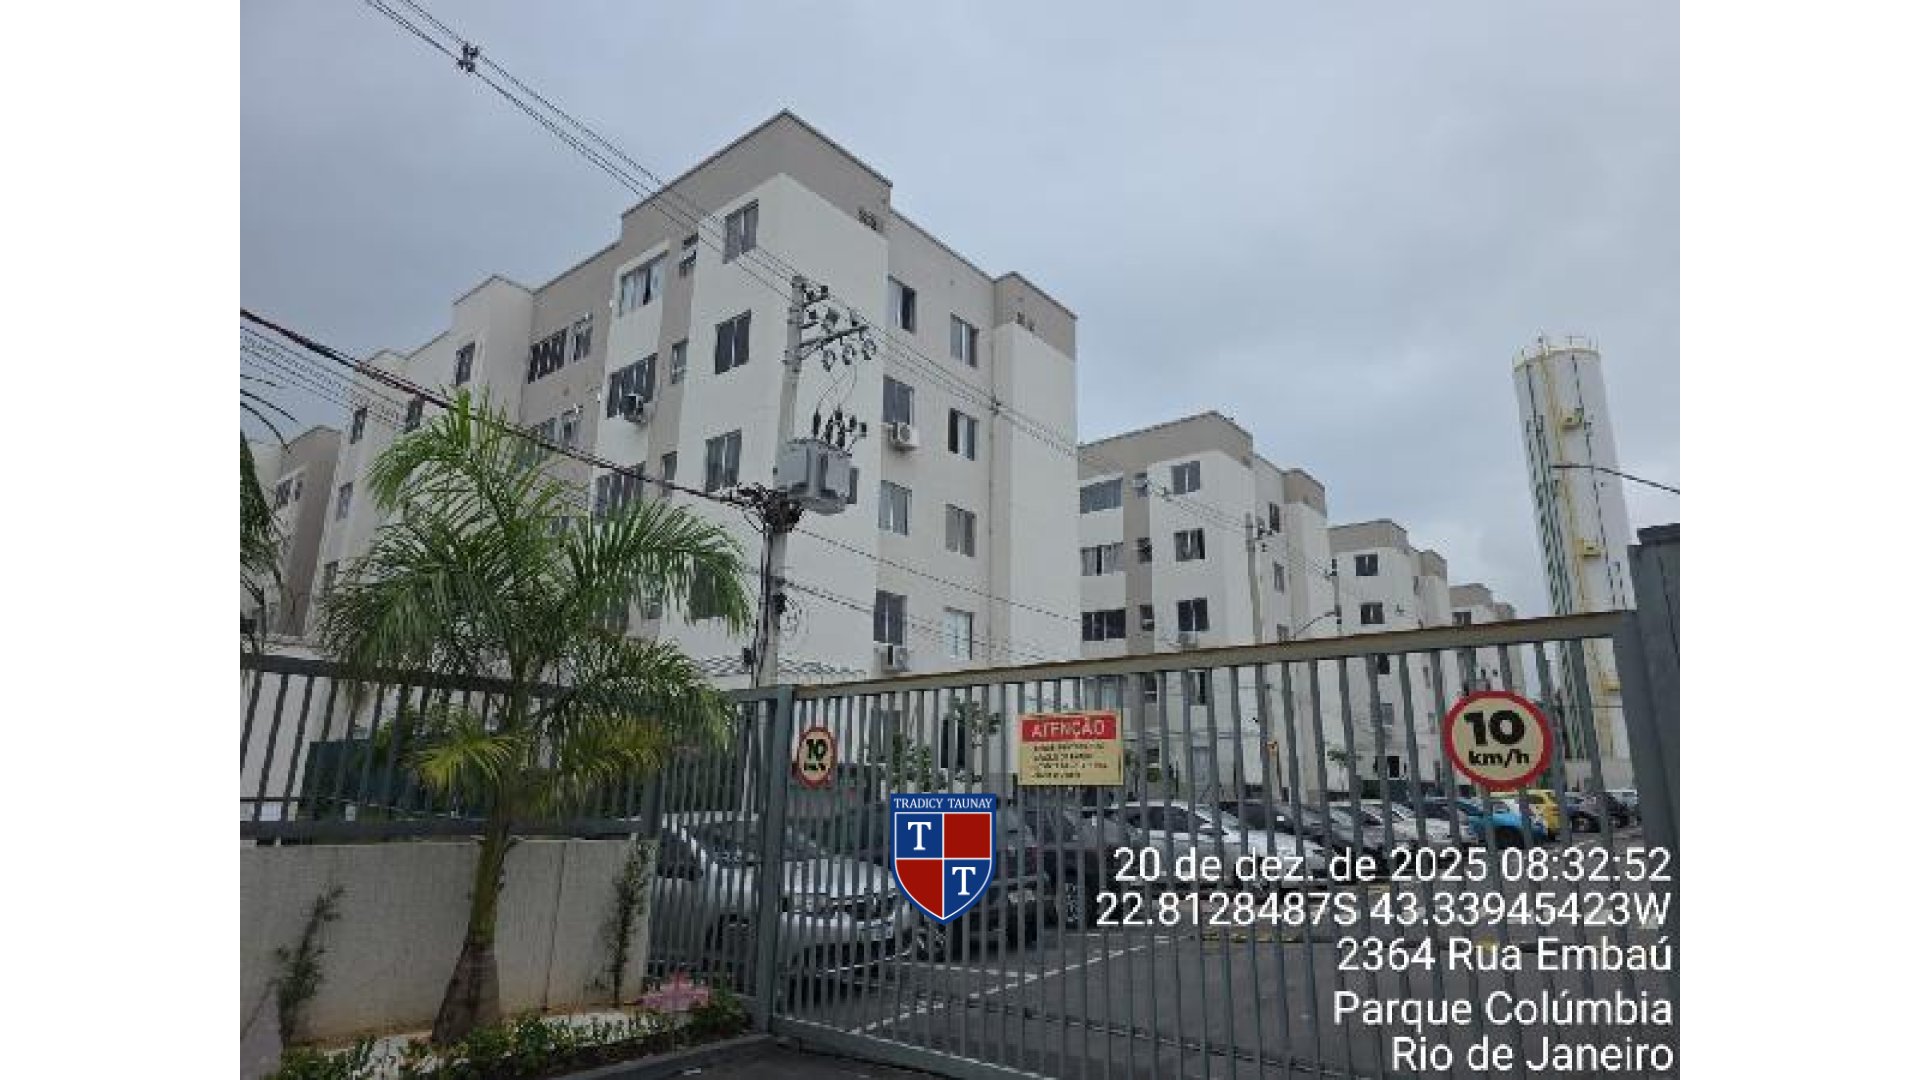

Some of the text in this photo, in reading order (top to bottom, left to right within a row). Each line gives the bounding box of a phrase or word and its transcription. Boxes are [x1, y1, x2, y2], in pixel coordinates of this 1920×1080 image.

[1031, 716, 1105, 739] ATENÇÃO
[1463, 710, 1525, 747] 10
[1468, 748, 1530, 769] km/h
